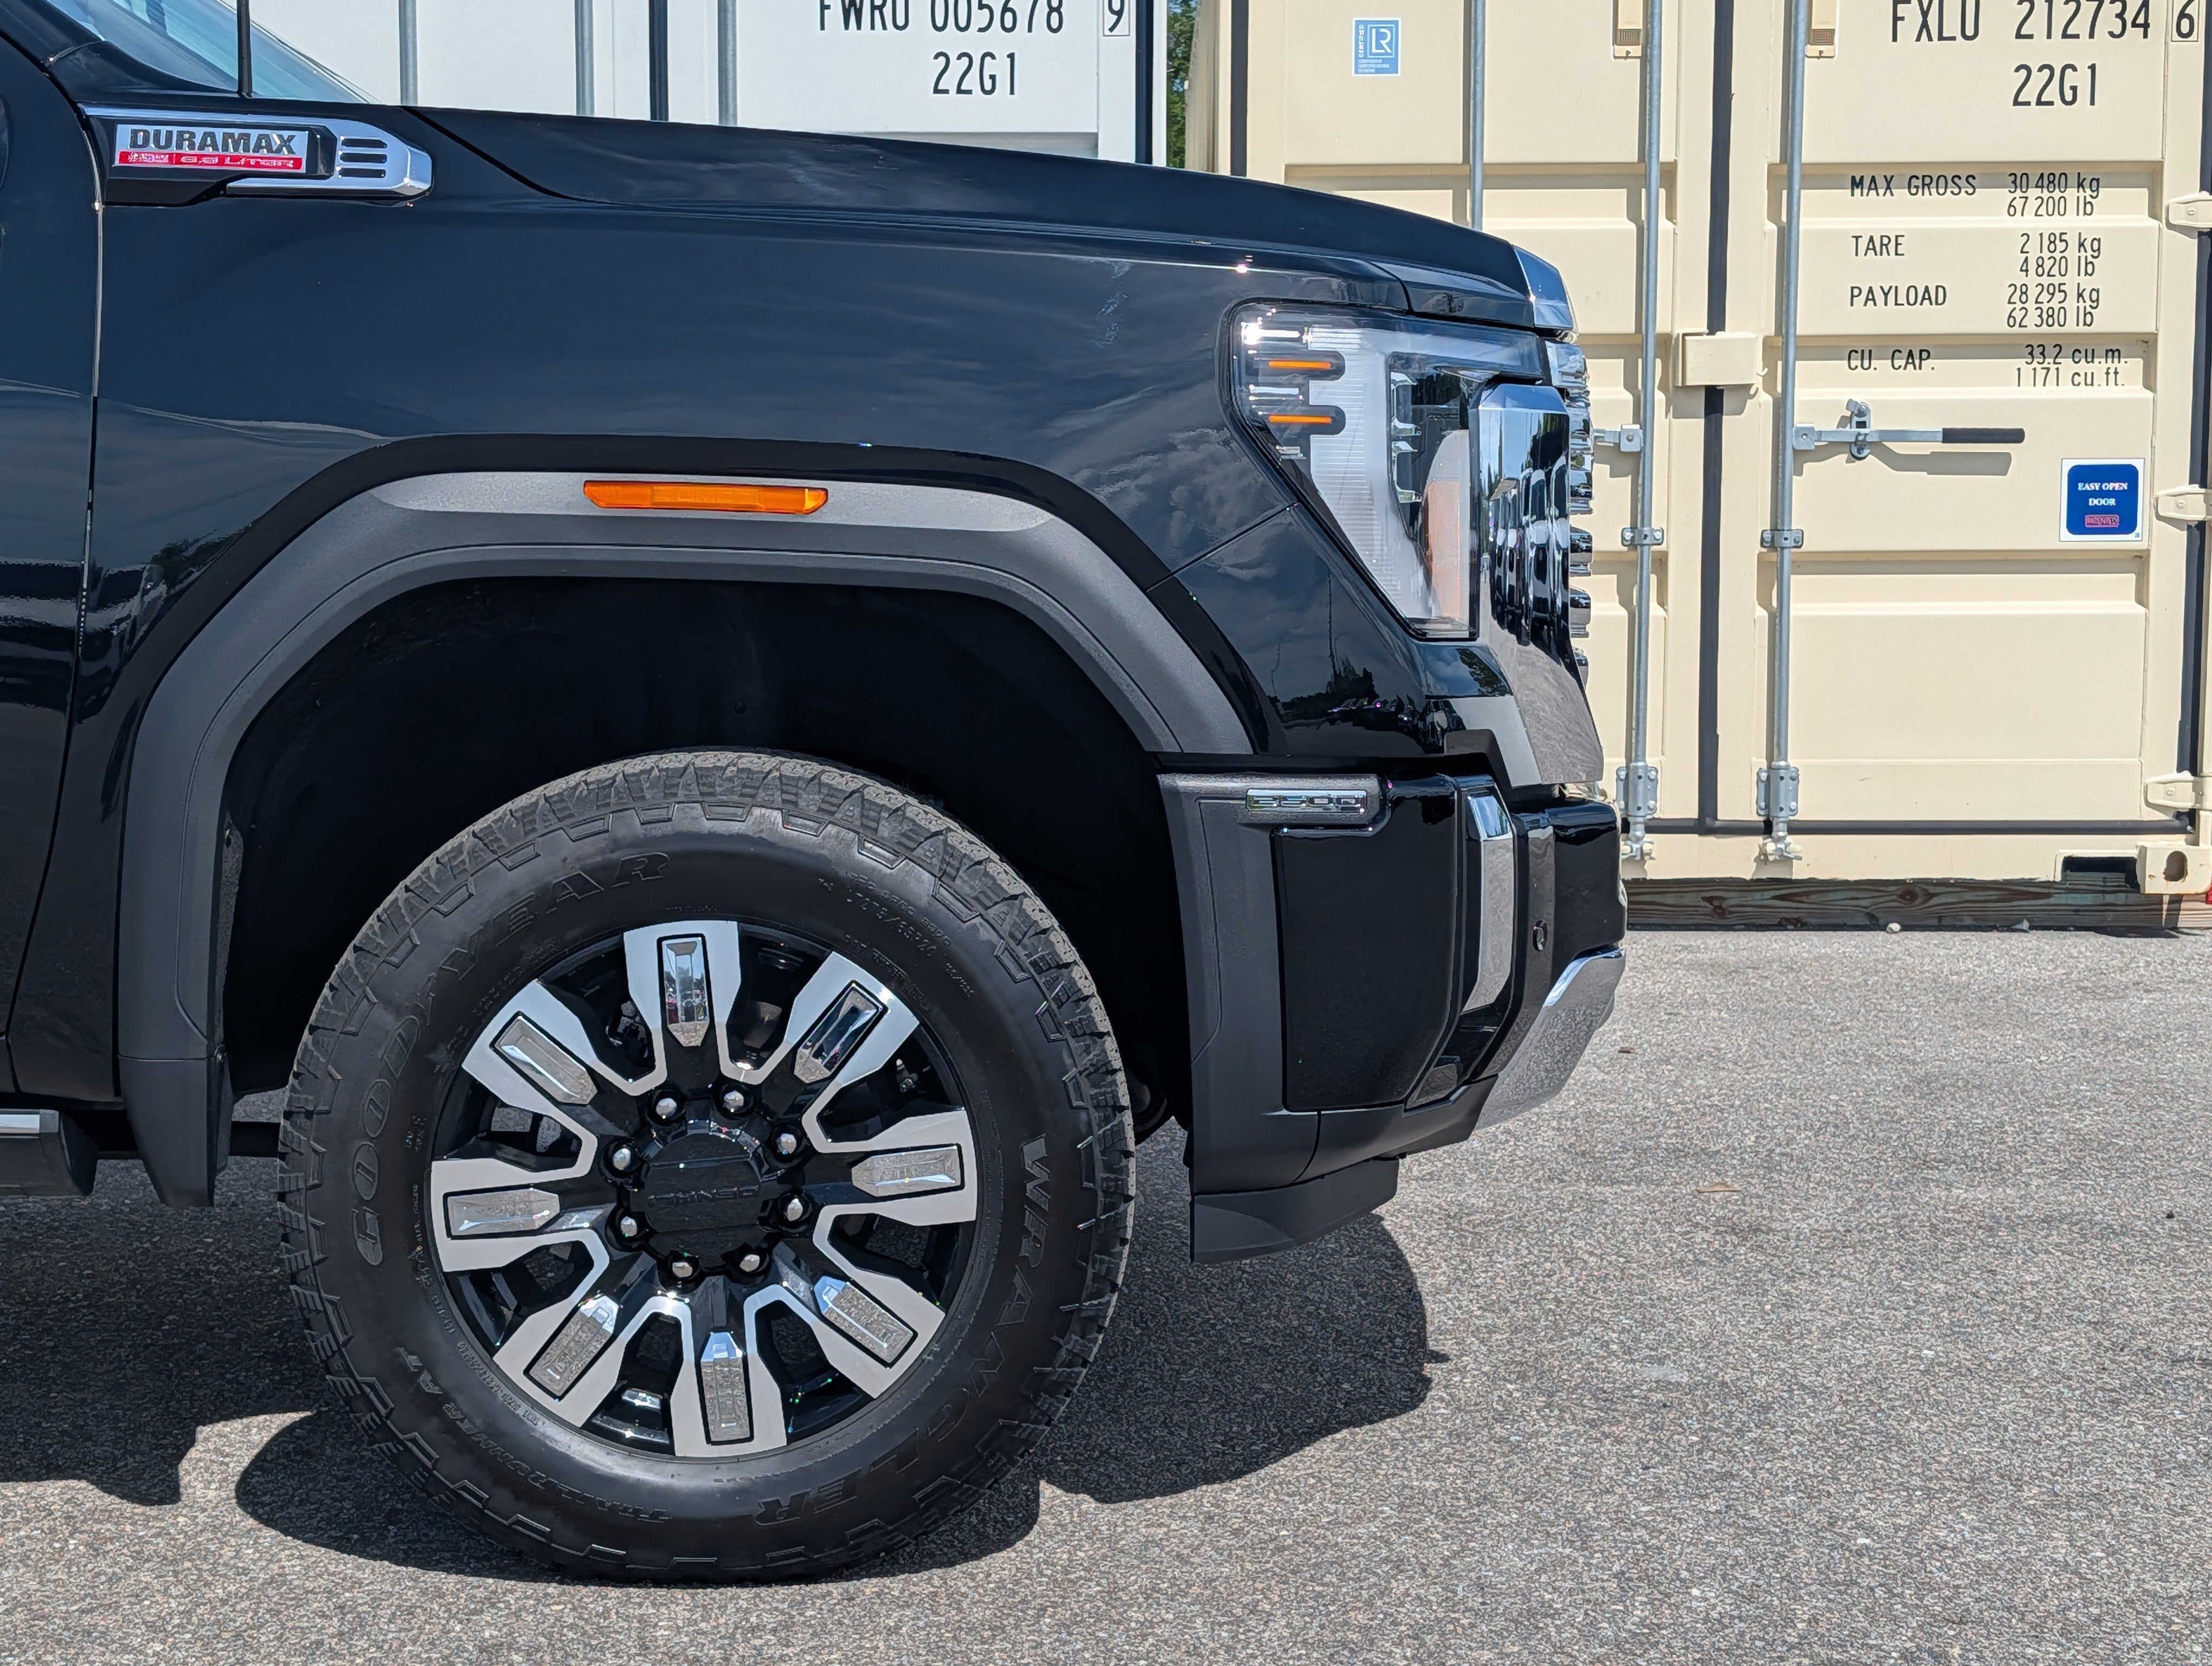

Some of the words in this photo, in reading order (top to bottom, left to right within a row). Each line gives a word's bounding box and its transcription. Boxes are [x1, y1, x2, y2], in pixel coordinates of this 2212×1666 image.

[819, 0, 910, 31] FWRU
[930, 0, 1064, 34] 005678
[1108, 0, 1125, 33] 9
[1892, 0, 1980, 43] FXLU
[2014, 0, 2151, 40] 212734
[2176, 0, 2195, 39] 6
[1371, 28, 1392, 53] LR
[933, 50, 1015, 95] 22G1
[2012, 63, 2097, 107] 22G1
[128, 128, 298, 155] DURAMAX
[1850, 175, 1894, 197] MAX
[1907, 174, 1976, 196] GROSS
[2076, 172, 2100, 200] kg
[2076, 196, 2094, 217] lb
[1851, 234, 1905, 257] TARE
[2078, 232, 2101, 261] kg
[2077, 255, 2096, 278] lb
[1850, 285, 1947, 307] PAYLOAD
[2076, 282, 2100, 311] kg
[2075, 306, 2094, 328] lb
[1847, 349, 1877, 371] CU.
[1891, 349, 1935, 371] CAP.
[2024, 343, 2062, 365] 33.2
[2078, 482, 2101, 491] EASY
[2101, 482, 2128, 491] OPEN
[2088, 497, 2116, 506] DOOR
[351, 851, 671, 1266] GOODYEAR
[755, 1133, 1051, 1528] WRANGLER
